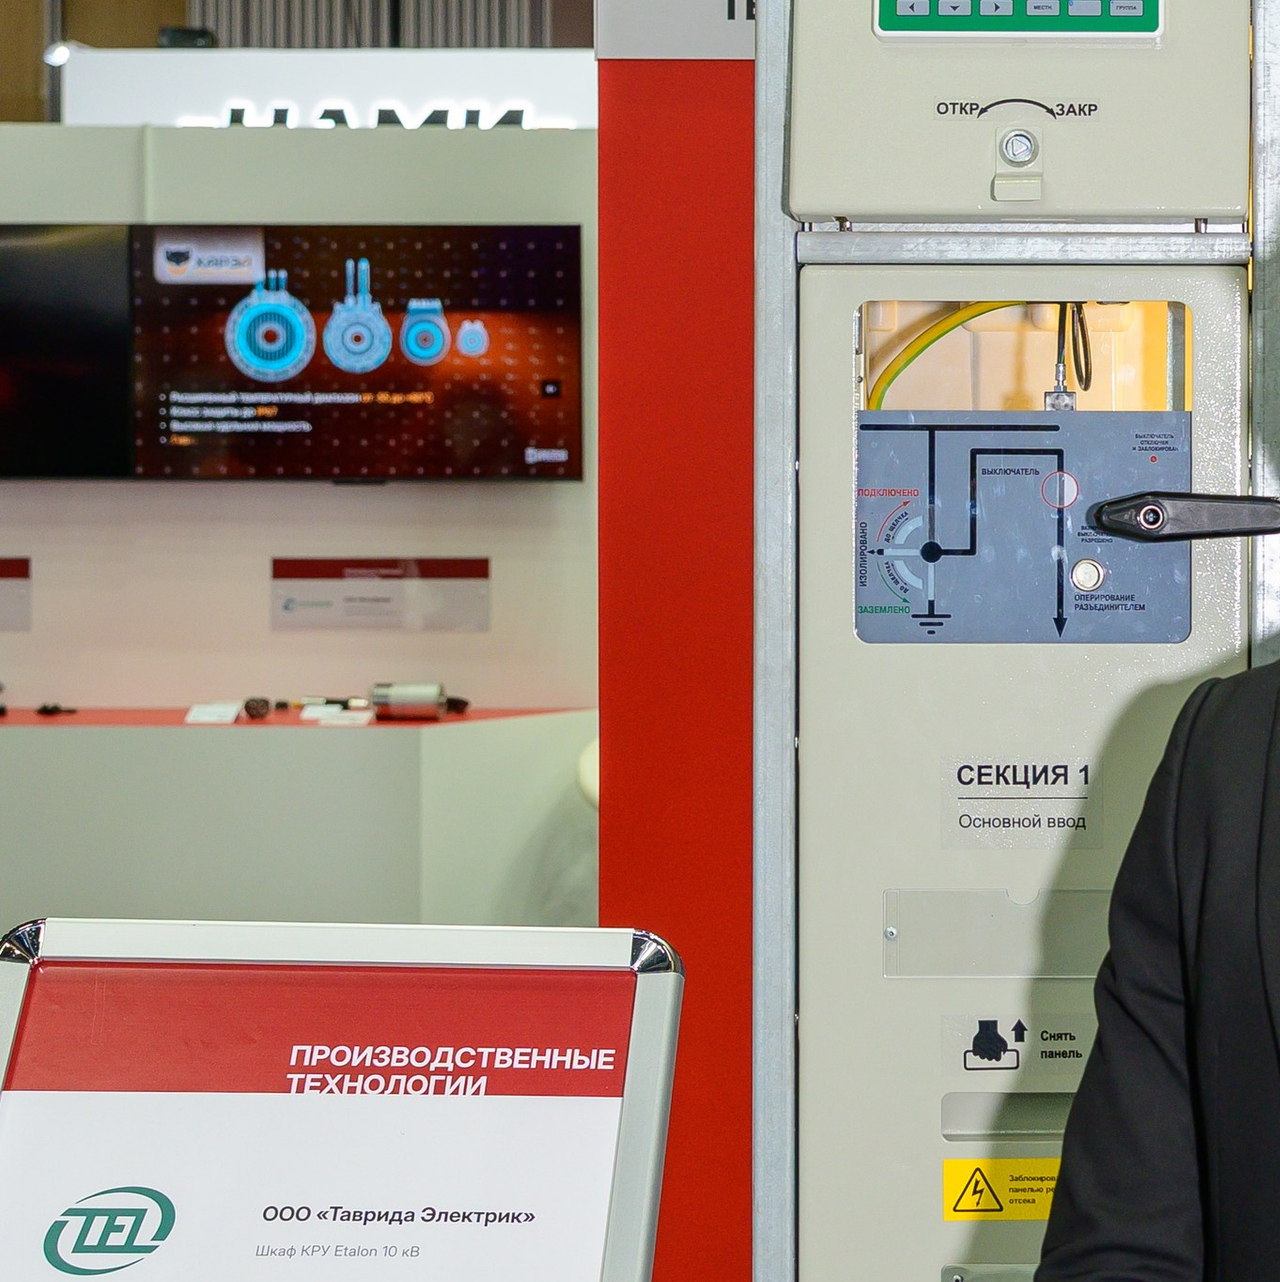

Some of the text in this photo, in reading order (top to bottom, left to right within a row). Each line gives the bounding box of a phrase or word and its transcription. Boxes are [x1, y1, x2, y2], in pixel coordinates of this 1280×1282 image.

[936, 102, 1098, 116] ОТКР ЗАКР
[981, 467, 1040, 476] ВЫКЛЮЧАТЕЛЬ
[858, 489, 919, 497] ПОДКЛЮЧЕНО
[956, 764, 1090, 789] СЕКЦИЯ 1
[958, 813, 1086, 830] Основной ввод
[1041, 1030, 1076, 1042] Снять
[290, 1045, 616, 1071] ПРОИЗВОДСТВЕННЫЕ
[1041, 1048, 1083, 1059] панель
[286, 1074, 487, 1096] ТЕХНОЛОГИИ
[263, 1206, 536, 1226] ООО «Таврида Электрик»
[256, 1245, 420, 1259] Шкаф КРУ Etalon 10 кВ
